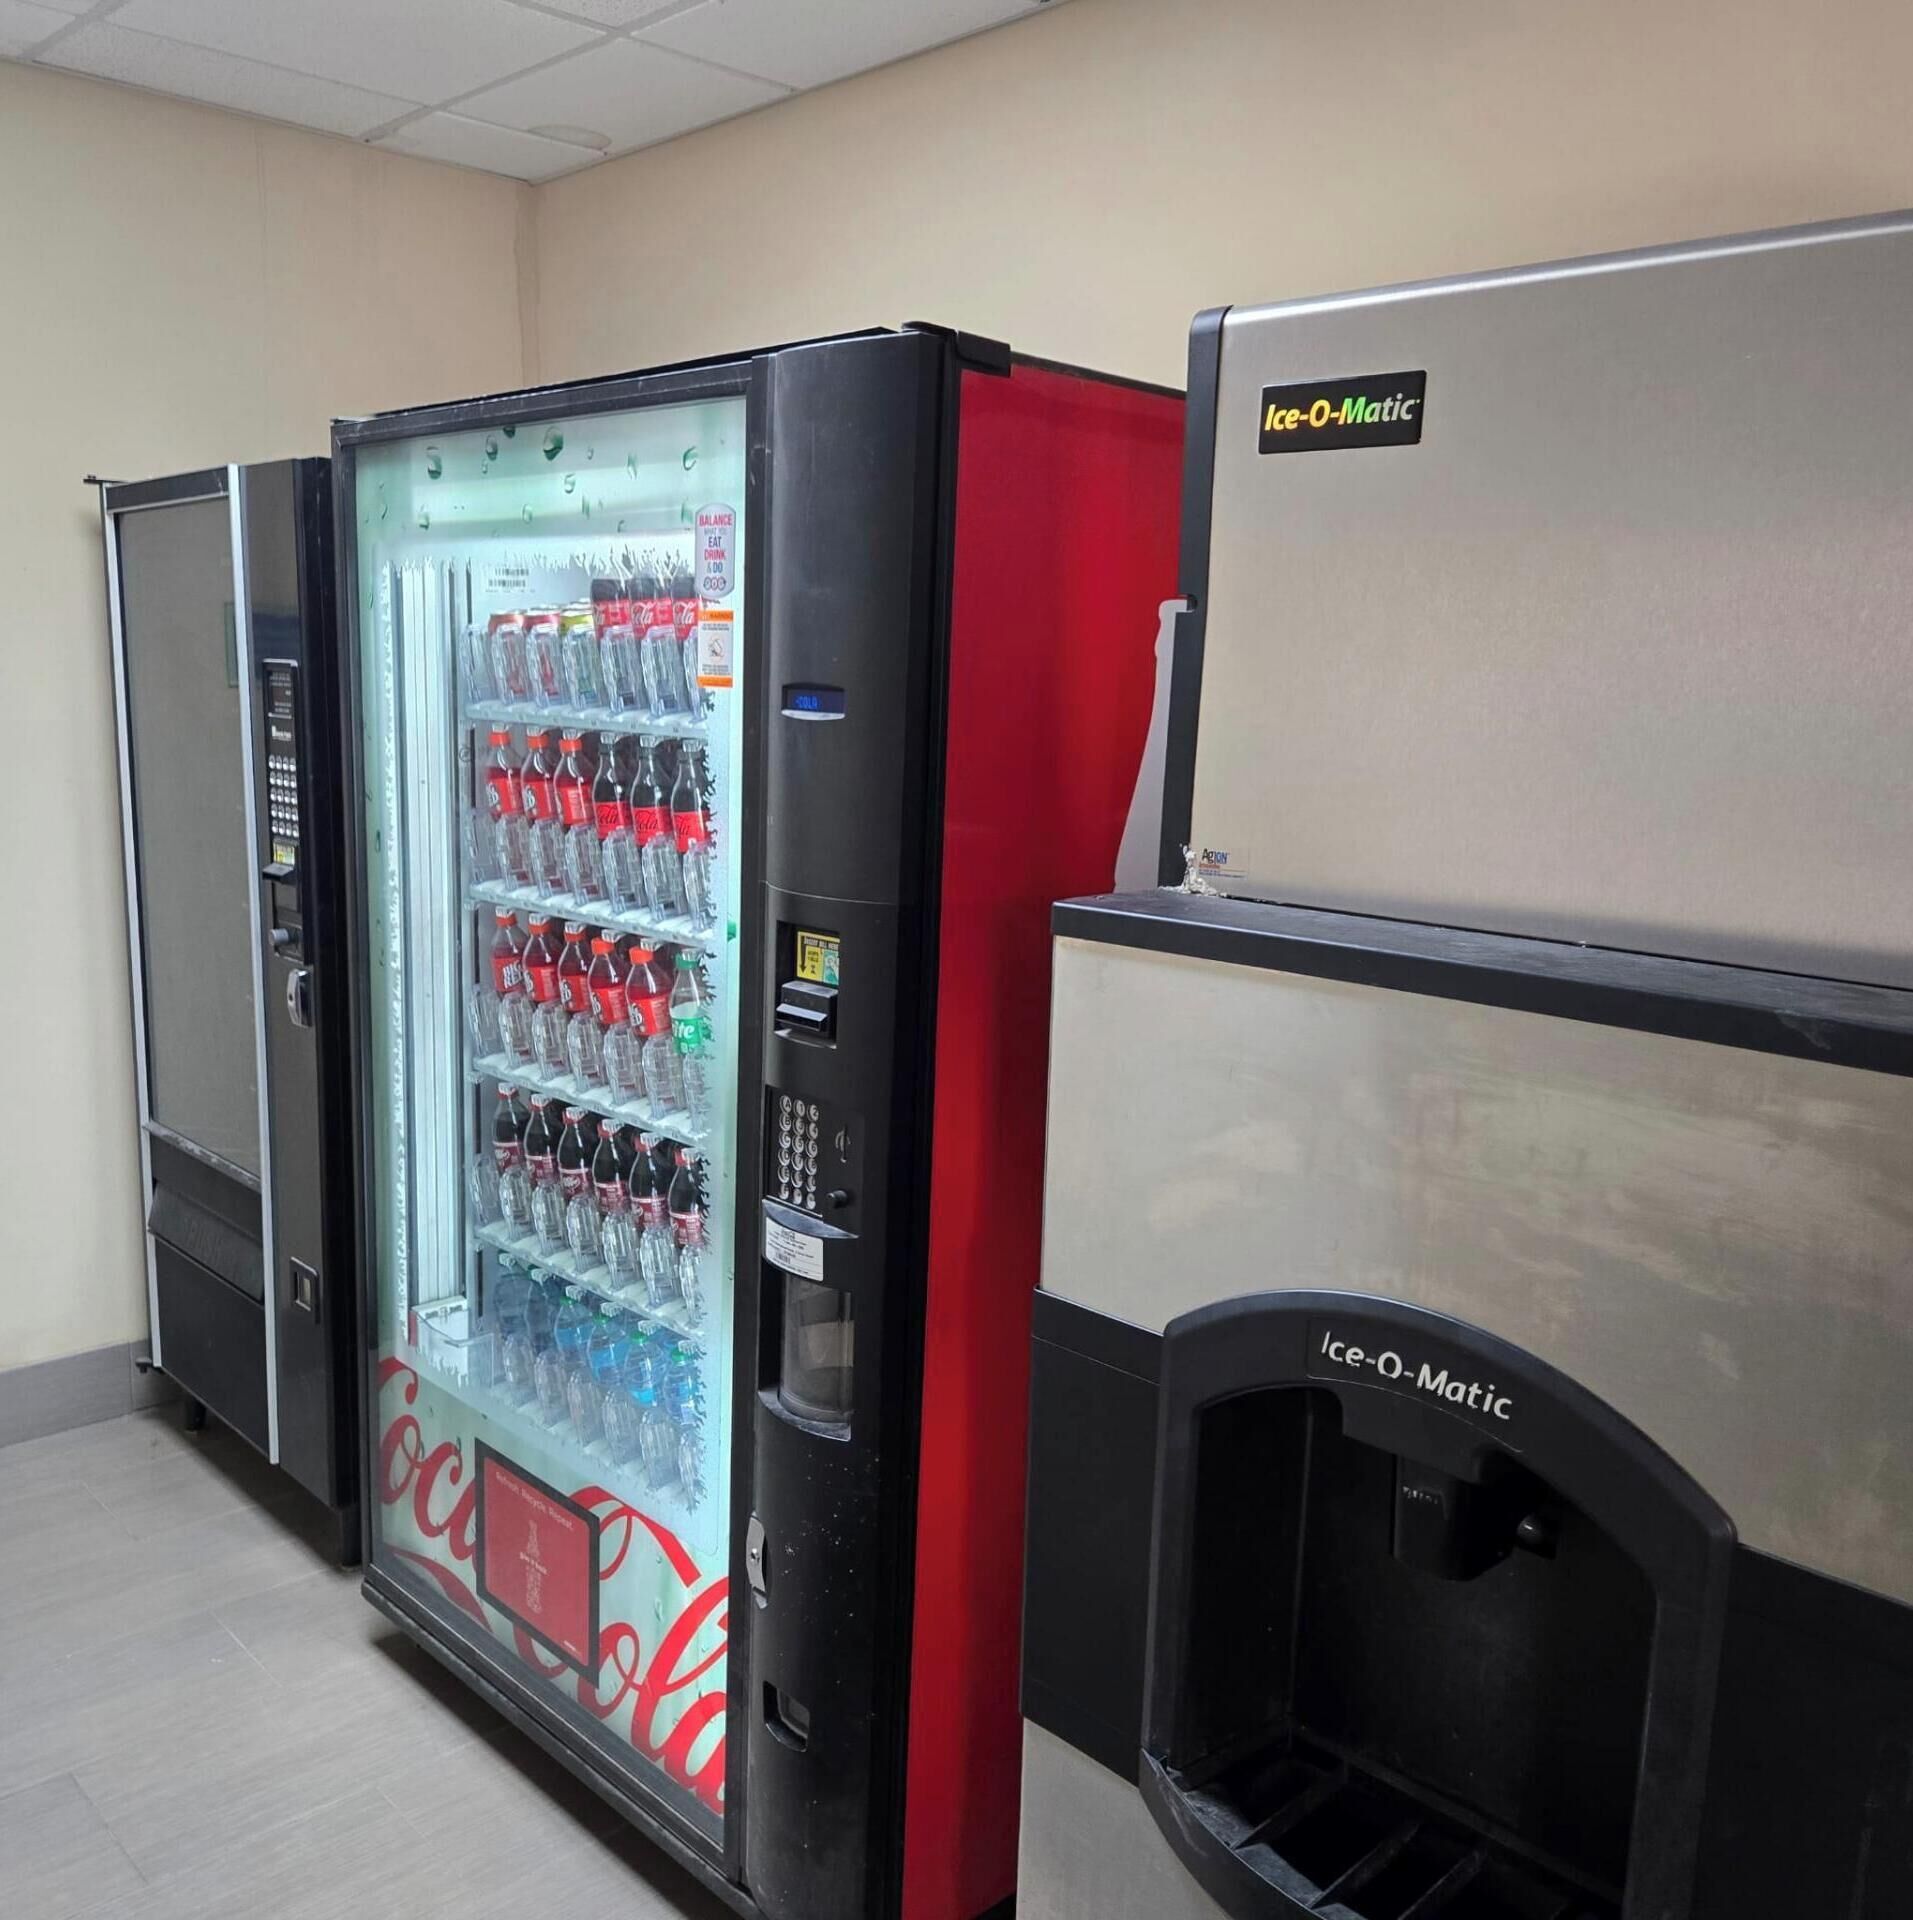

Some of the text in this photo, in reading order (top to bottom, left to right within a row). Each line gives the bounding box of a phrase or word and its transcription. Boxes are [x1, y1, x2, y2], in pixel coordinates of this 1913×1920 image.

[1264, 393, 1421, 431] Ice-O-Matic
[699, 513, 732, 527] BALANCE
[708, 535, 722, 548] EAT
[704, 549, 726, 561] DRINK
[713, 562, 723, 573] DO
[1321, 1331, 1513, 1420] Ice-O-Matic
